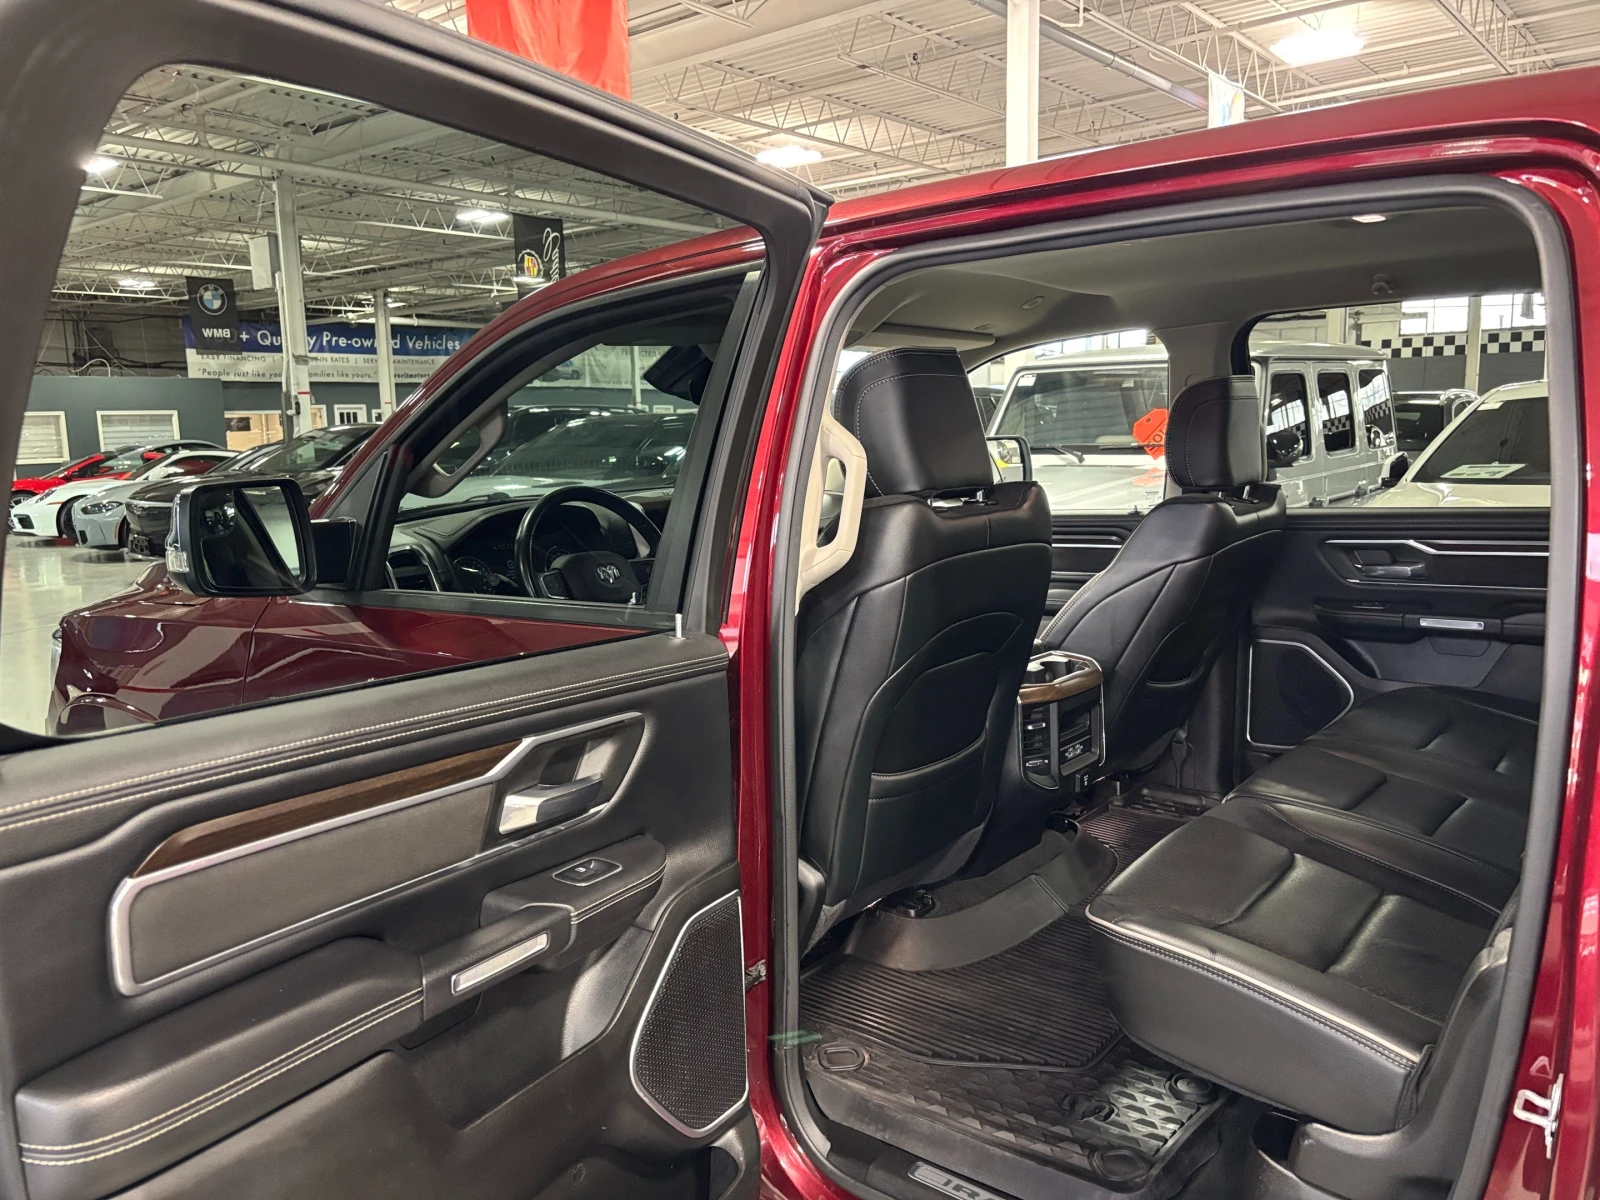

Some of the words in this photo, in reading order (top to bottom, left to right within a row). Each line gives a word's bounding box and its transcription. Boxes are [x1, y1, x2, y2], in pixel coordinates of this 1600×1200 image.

[322, 331, 401, 349] Pre-owd
[406, 334, 461, 350] Vehicles
[223, 354, 267, 363] FINANCING
[330, 356, 350, 364] RATES
[234, 369, 249, 378] just
[252, 370, 266, 378] like
[308, 370, 335, 378] amilies
[337, 370, 350, 378] like
